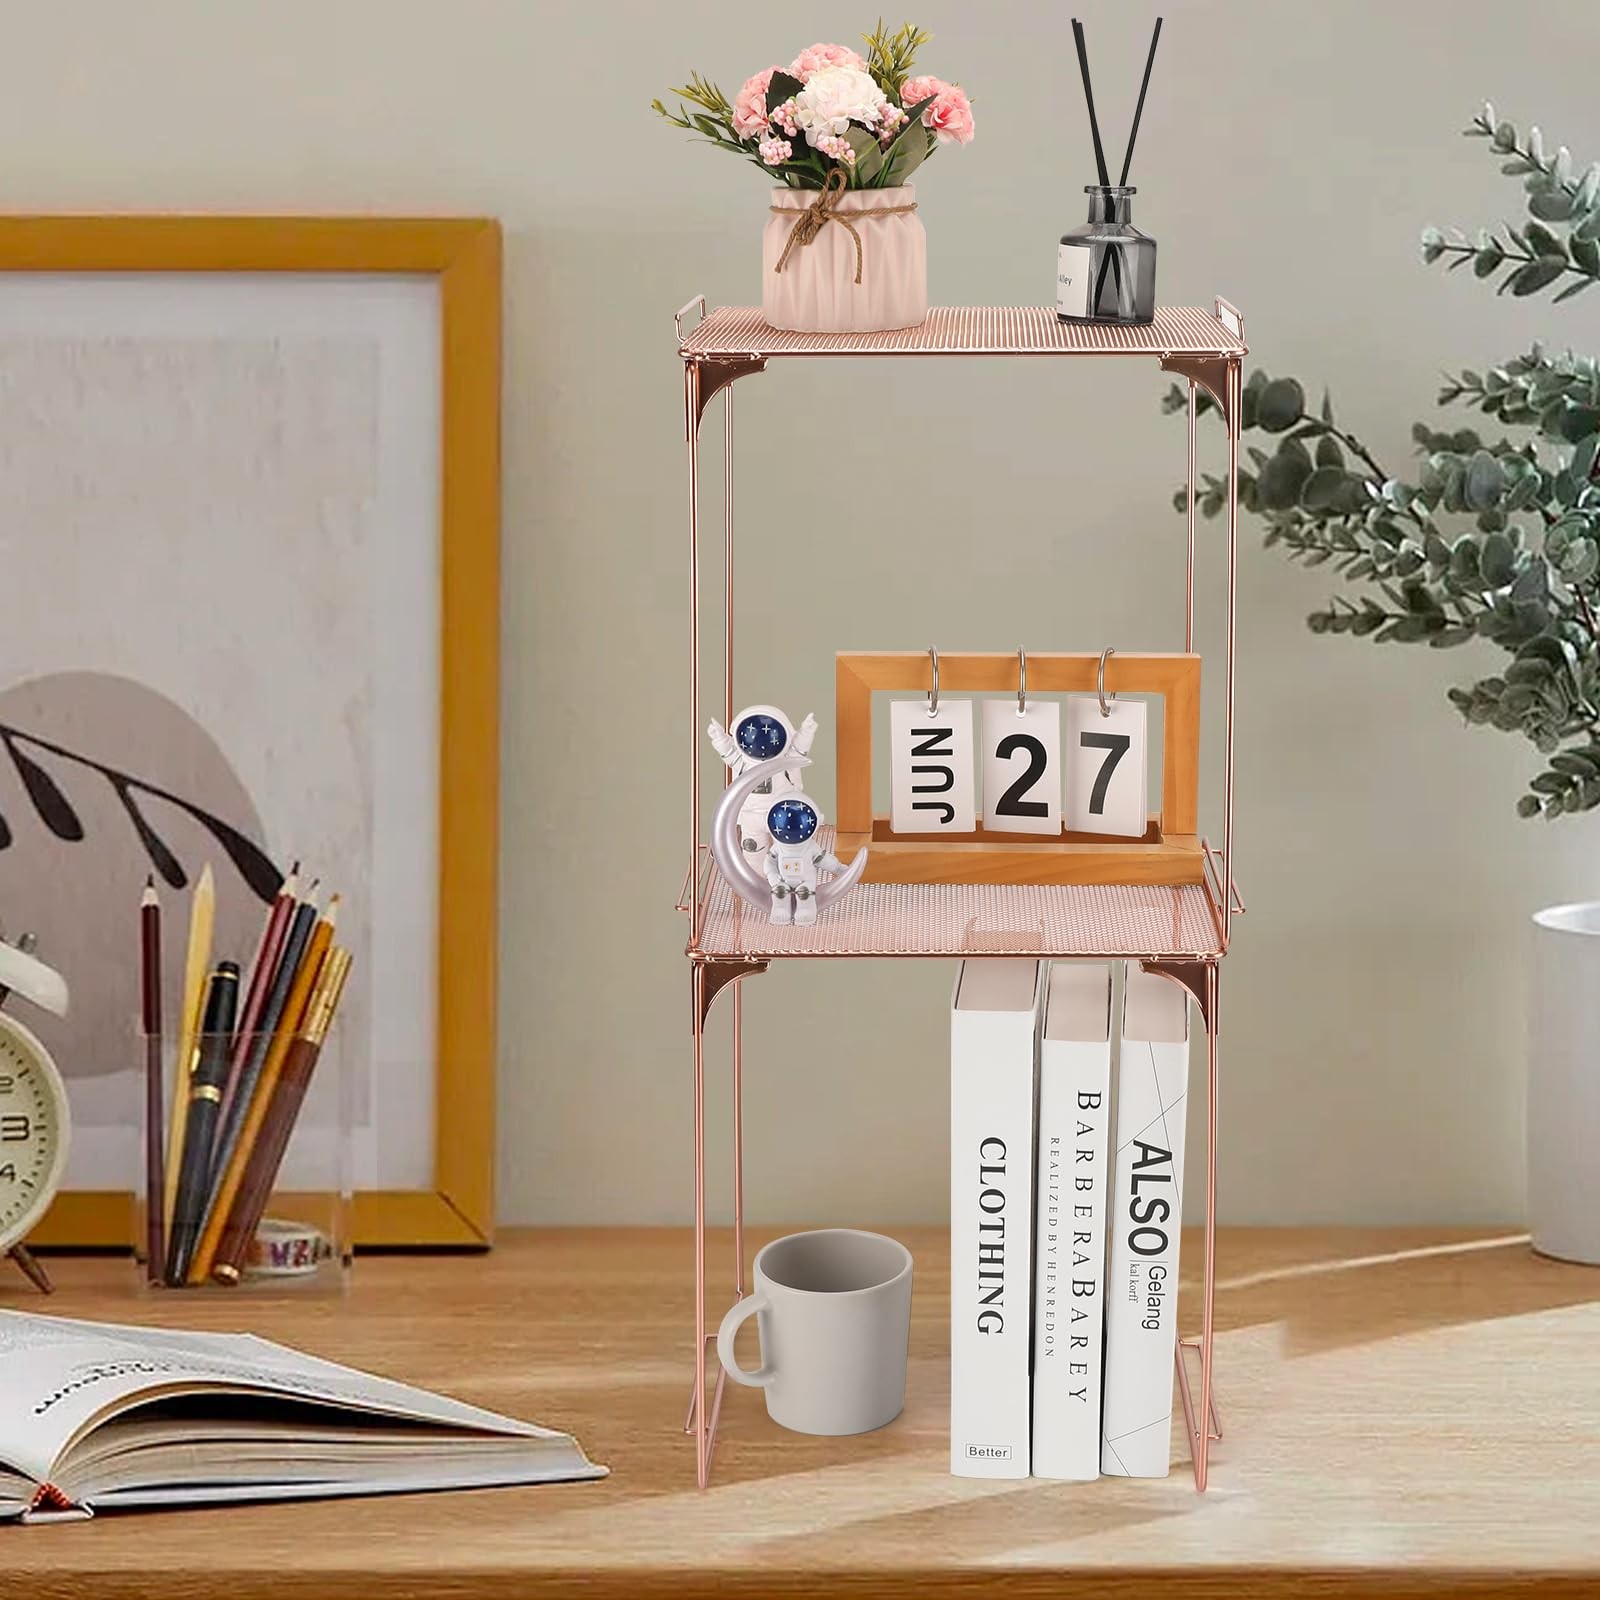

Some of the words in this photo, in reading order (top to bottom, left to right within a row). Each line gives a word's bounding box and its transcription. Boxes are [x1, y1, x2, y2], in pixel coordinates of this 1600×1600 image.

[910, 728, 955, 824] JUN
[2, 1116, 30, 1141] 3
[1048, 1137, 1060, 1227] REALIZED
[1127, 1139, 1173, 1256] ALSO
[977, 1136, 1007, 1336] CLOTHING
[1047, 1234, 1058, 1255] BY
[1044, 1261, 1057, 1357] HENREDON
[1141, 1265, 1168, 1330] Gelang
[969, 1446, 1008, 1458] Better
